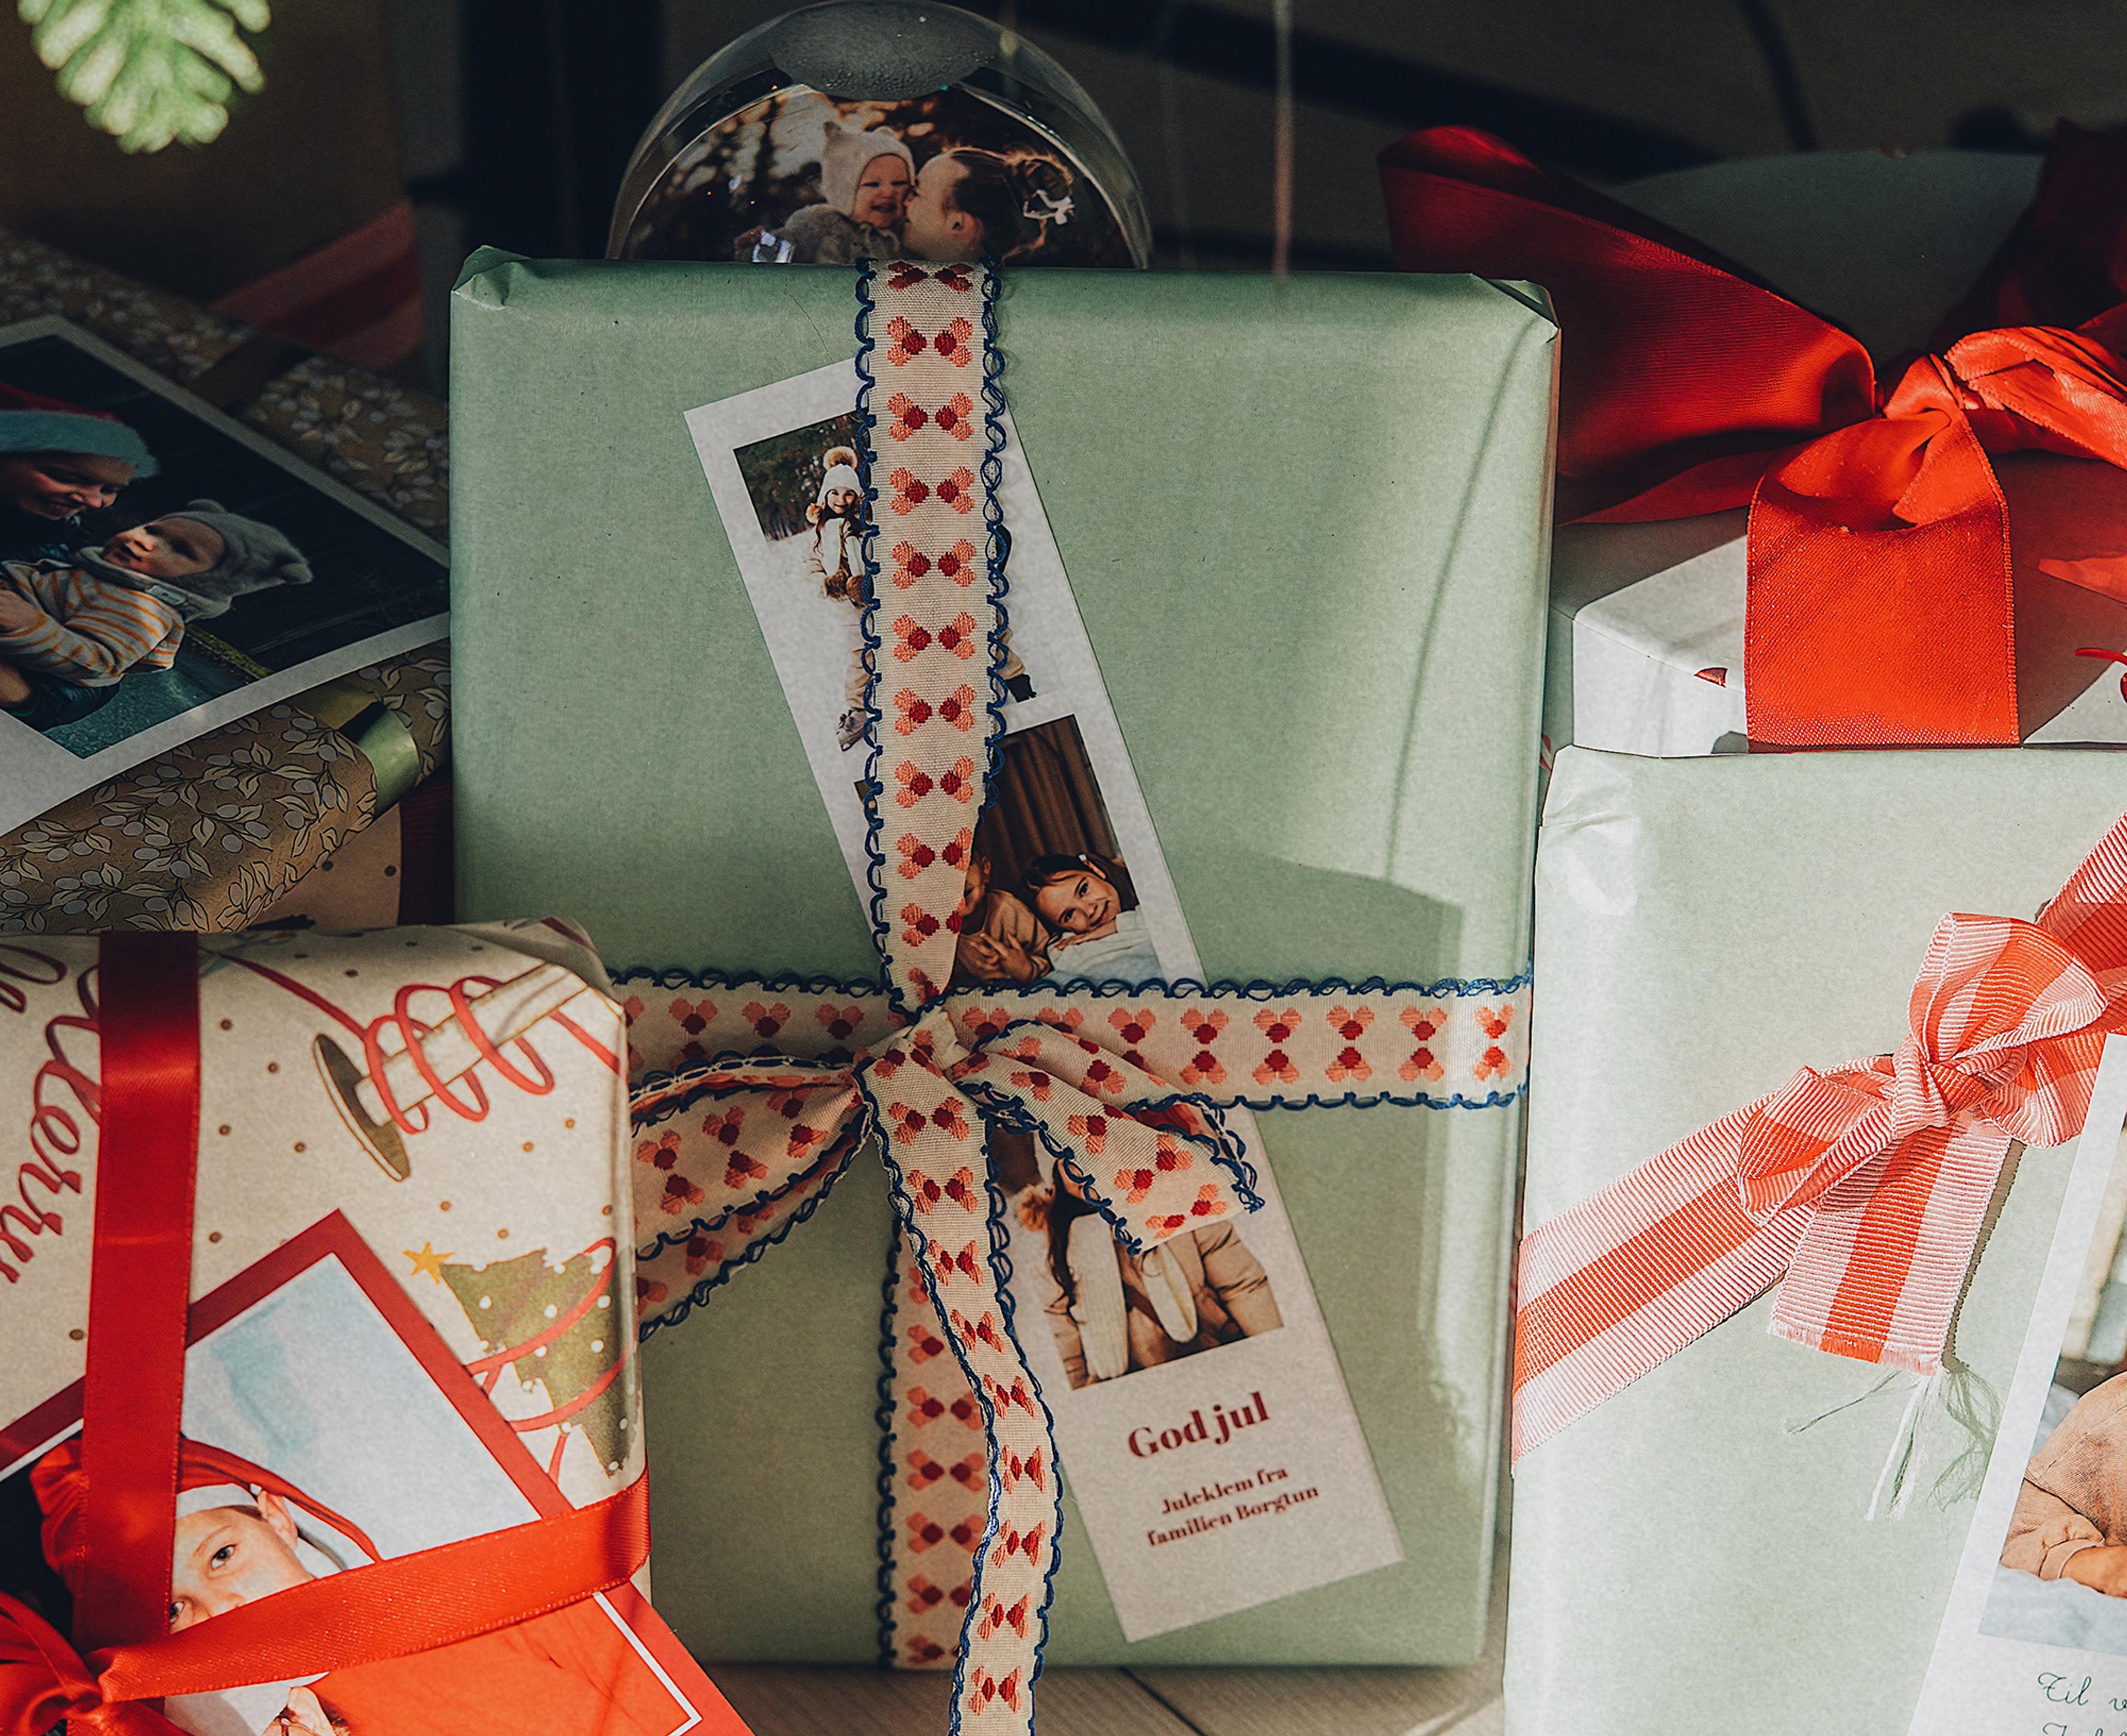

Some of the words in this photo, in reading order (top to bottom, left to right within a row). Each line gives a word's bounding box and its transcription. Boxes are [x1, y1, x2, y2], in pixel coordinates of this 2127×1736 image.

[1128, 1410, 1209, 1457] God
[1213, 1392, 1270, 1445] jul
[1148, 1515, 1232, 1546] familien
[1236, 1488, 1318, 1519] Borgtun
[1163, 1479, 1253, 1514] Juleklem
[1256, 1468, 1288, 1486] fra
[2037, 1672, 2092, 1706] Til
